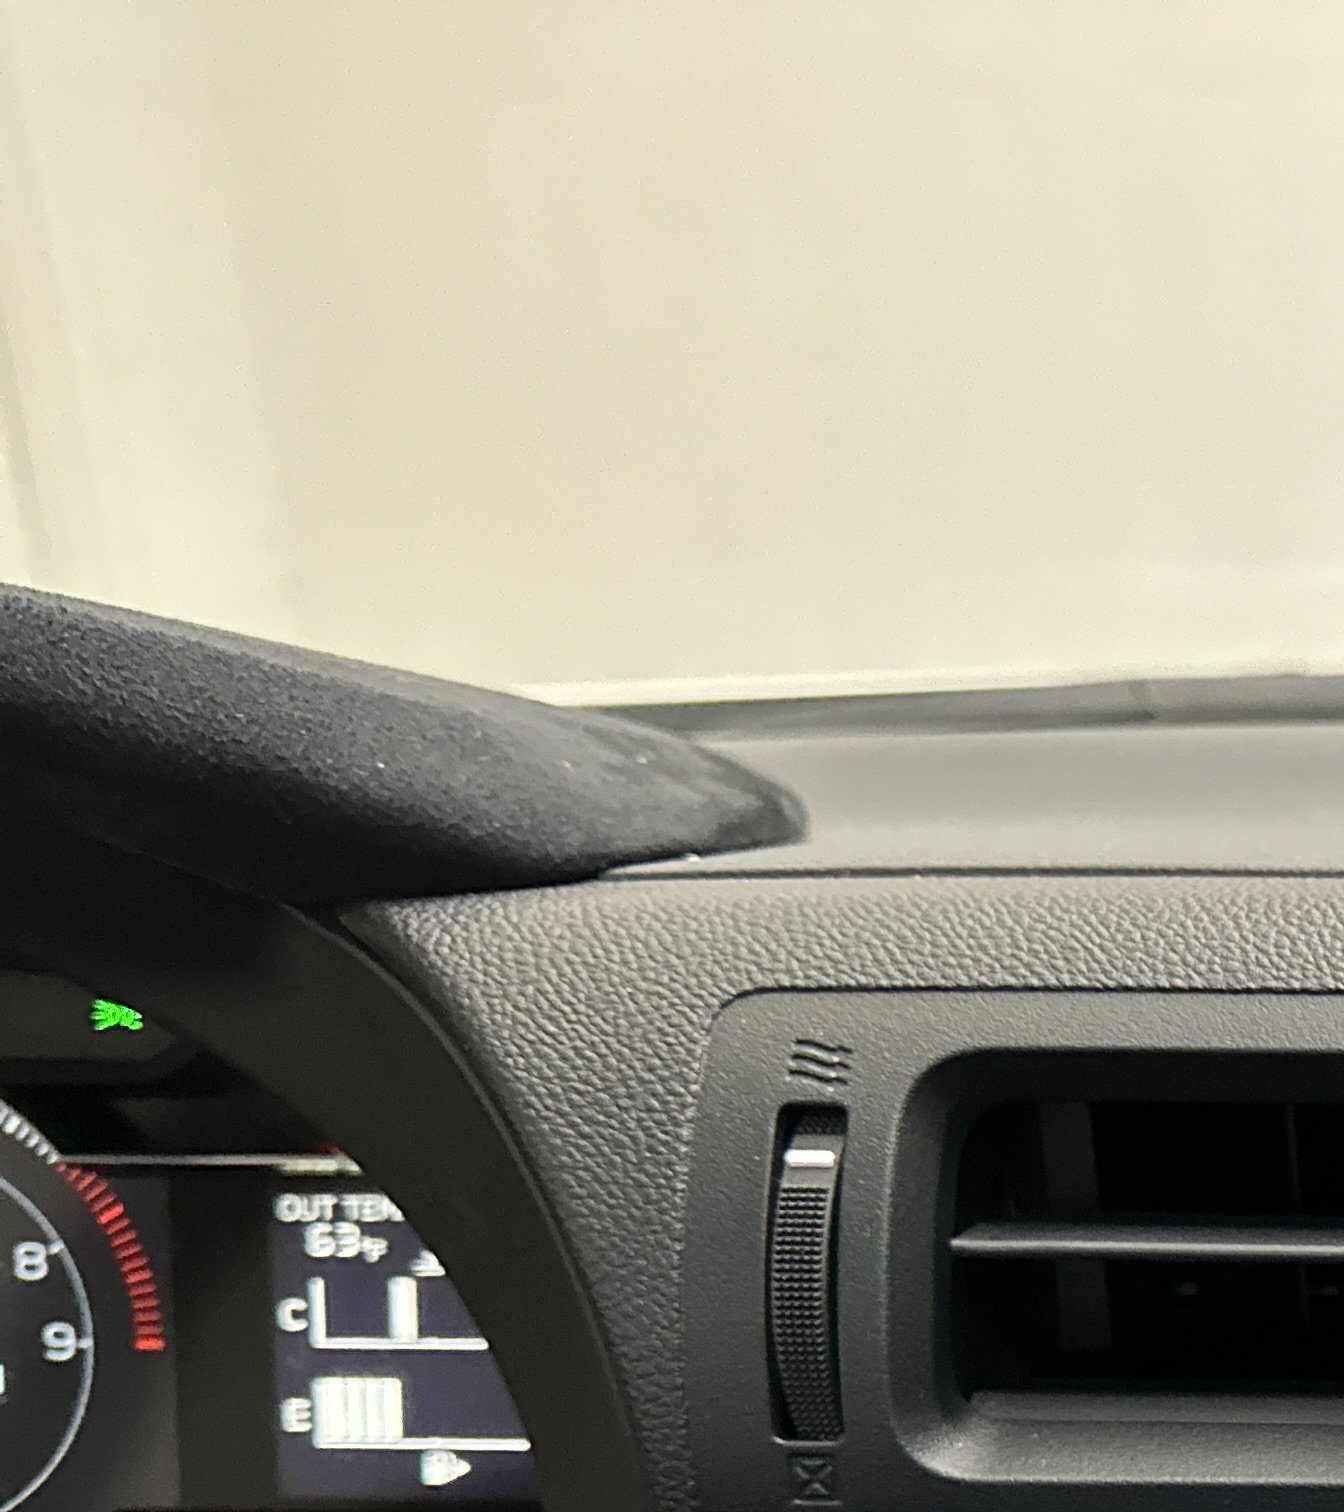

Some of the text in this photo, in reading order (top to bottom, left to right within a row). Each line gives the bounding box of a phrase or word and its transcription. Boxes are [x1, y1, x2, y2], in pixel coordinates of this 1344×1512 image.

[273, 1193, 338, 1222] OUT
[304, 1221, 361, 1257] 63
[13, 1241, 49, 1281] 8
[276, 1297, 308, 1332] C
[41, 1321, 77, 1361] 9
[280, 1397, 312, 1432] E
